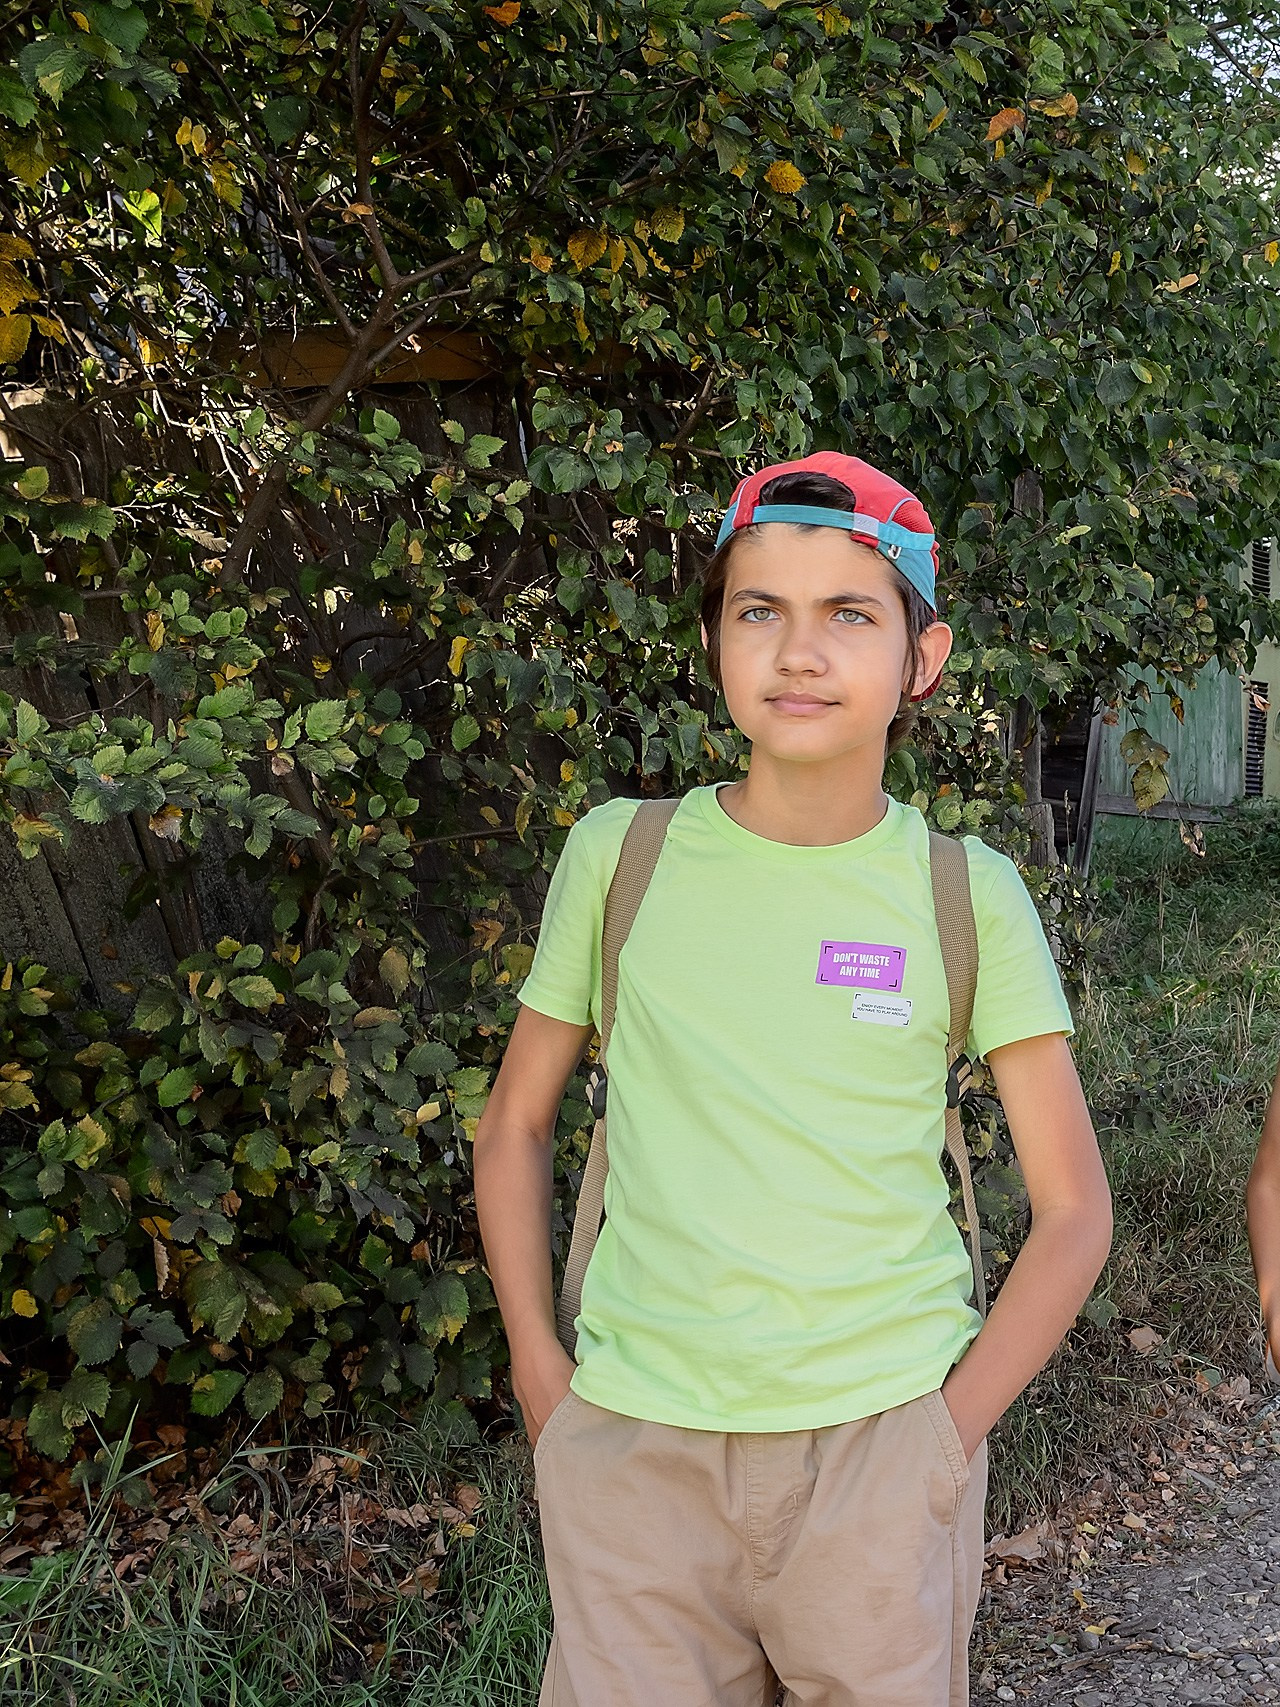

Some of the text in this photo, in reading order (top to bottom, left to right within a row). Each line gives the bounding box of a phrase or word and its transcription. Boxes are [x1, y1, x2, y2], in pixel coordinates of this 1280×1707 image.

[833, 952, 890, 967] DON'T WASTE
[839, 965, 881, 979] ANY TIME
